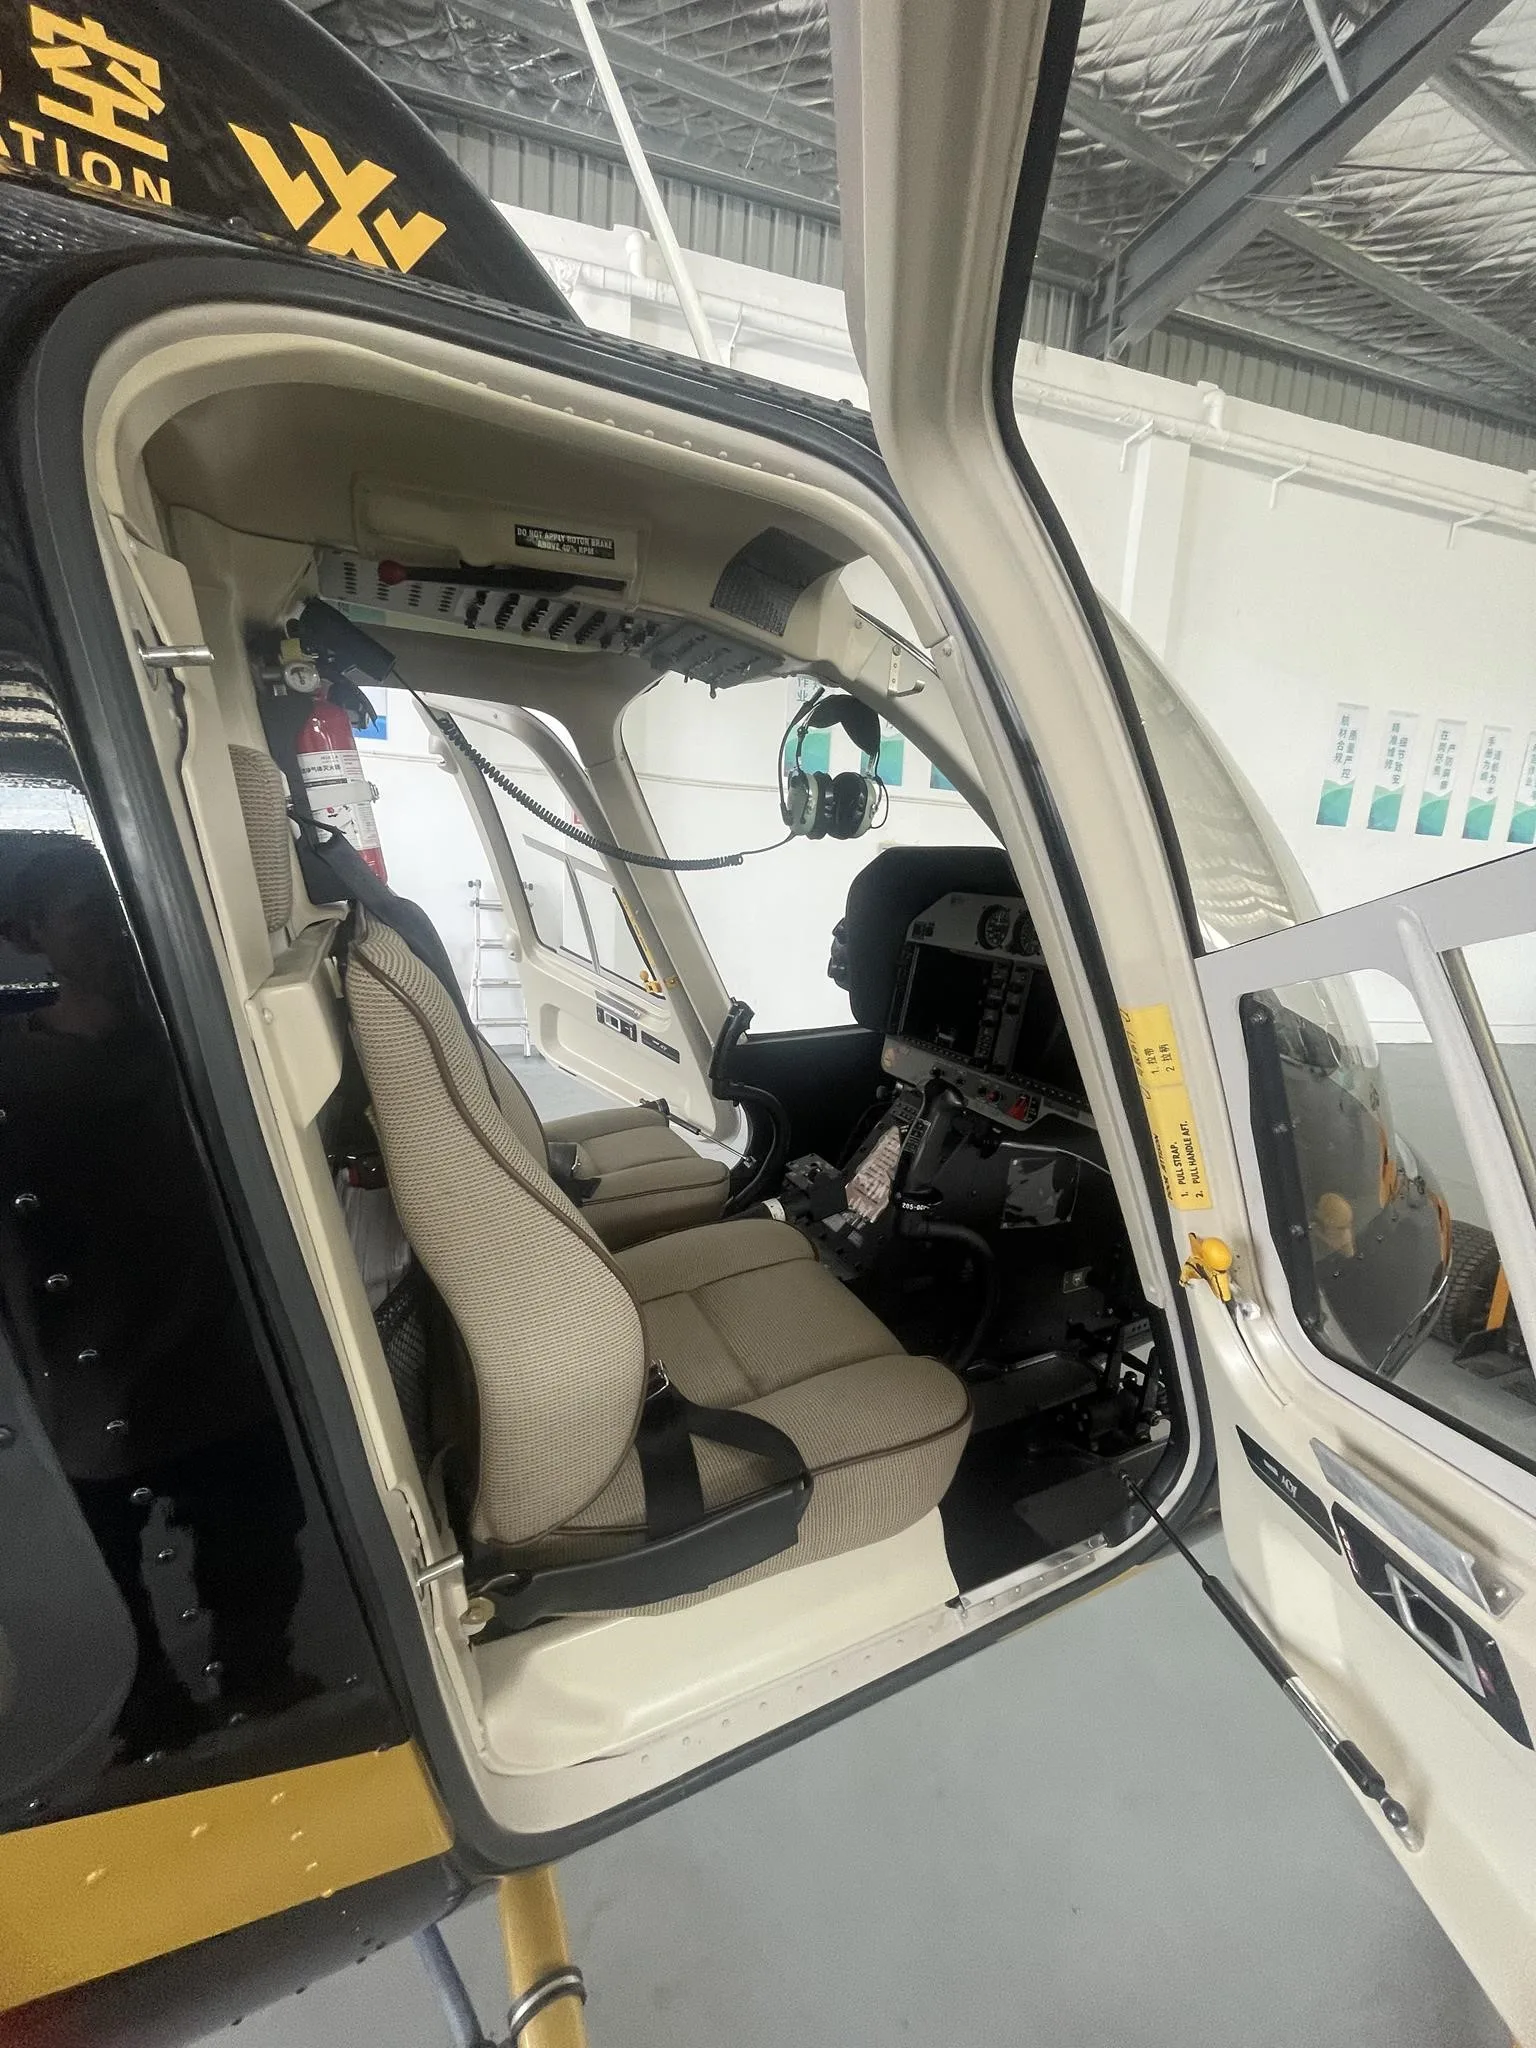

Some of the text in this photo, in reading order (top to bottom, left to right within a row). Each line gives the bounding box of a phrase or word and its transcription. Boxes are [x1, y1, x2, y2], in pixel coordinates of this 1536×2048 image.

[0, 120, 173, 207] TION
[517, 527, 527, 537] DO
[529, 529, 543, 539] NOT
[545, 532, 566, 543] APPLY
[591, 538, 613, 550] BRAKE
[1144, 1047, 1158, 1065] 拉带
[1180, 1121, 1191, 1137] AFT.
[1170, 1142, 1182, 1167] STRAP.
[1183, 1138, 1197, 1166] HANDLE
[1176, 1168, 1187, 1185] PULL
[1189, 1167, 1200, 1184] PULL
